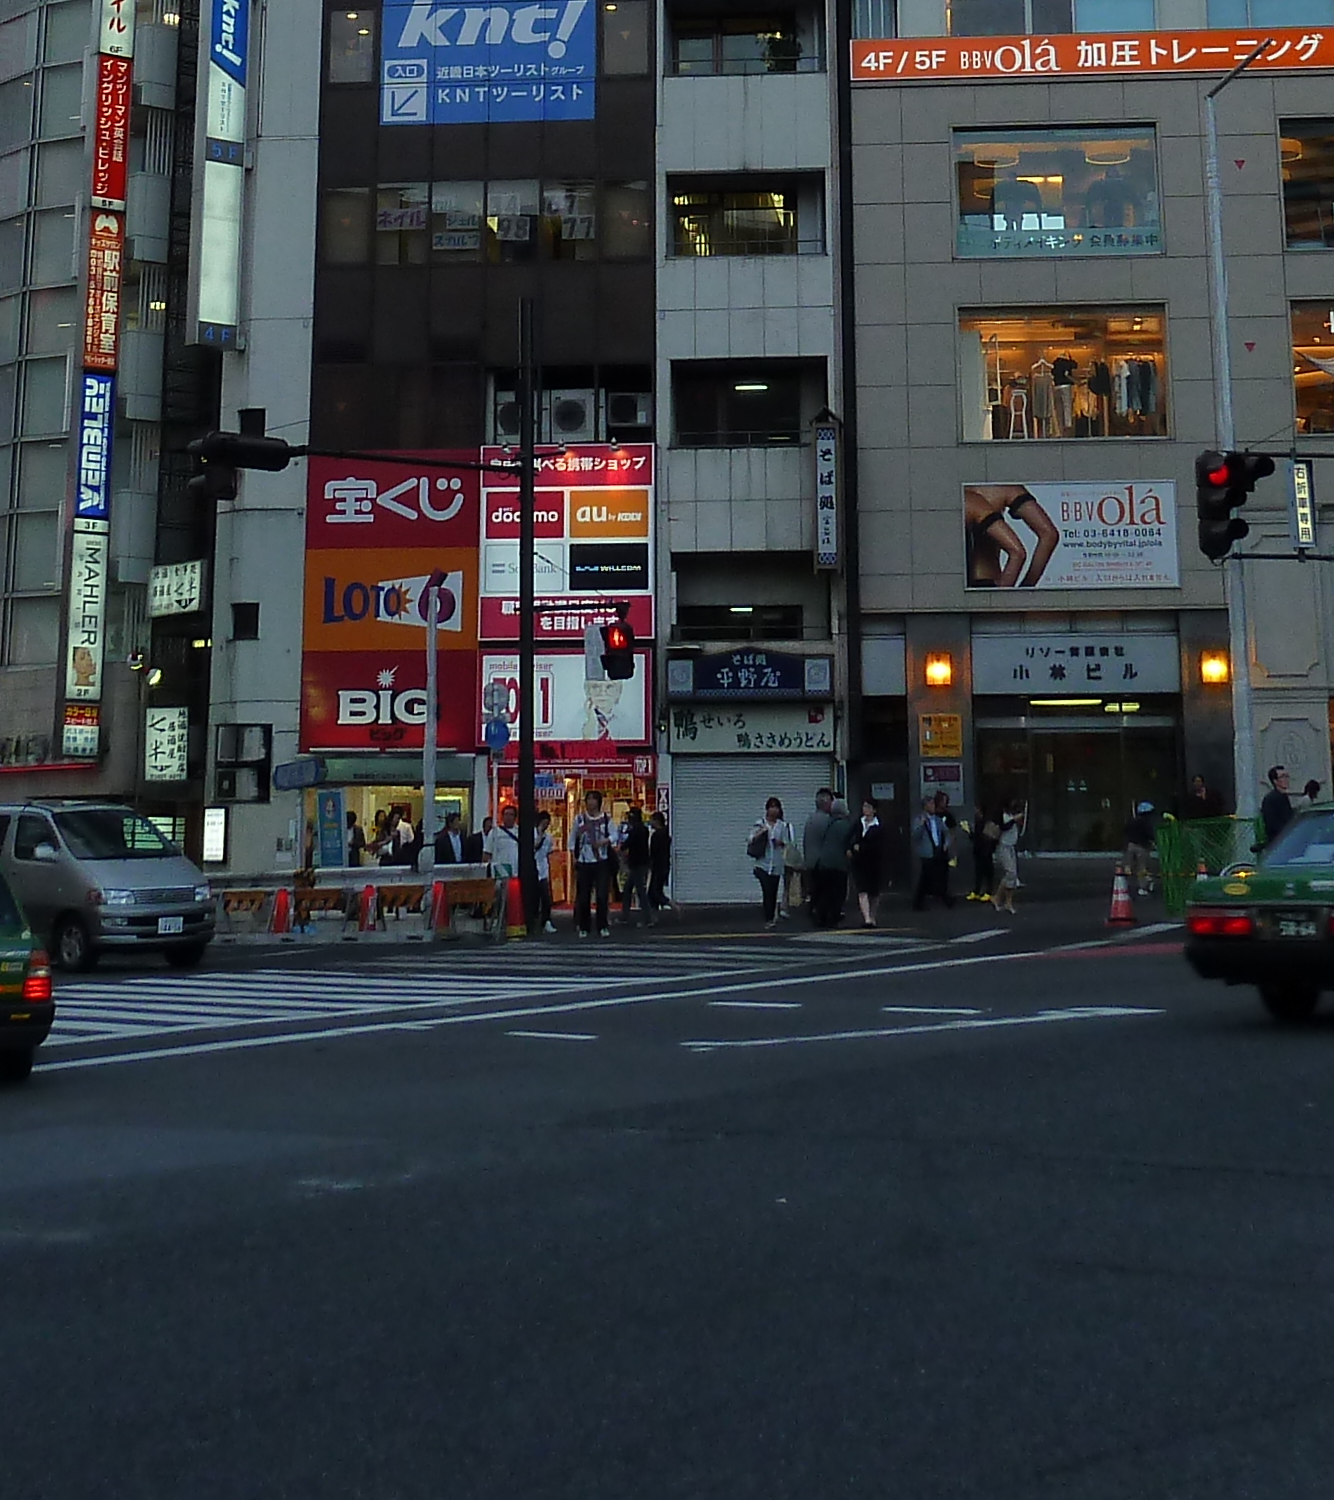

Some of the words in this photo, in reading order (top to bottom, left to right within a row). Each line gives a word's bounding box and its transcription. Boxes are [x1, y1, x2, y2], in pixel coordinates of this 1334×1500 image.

[394, 66, 417, 77] 入口
[100, 250, 120, 354] 駅前保育室
[205, 326, 230, 342] 4F
[79, 377, 105, 512] WEMBLEY
[324, 476, 464, 523] 宝くじ
[492, 508, 559, 523] docmo
[576, 506, 607, 523] au
[84, 521, 98, 530] 3F
[508, 562, 557, 574] SoBank
[81, 546, 102, 646] MAHLER
[323, 577, 401, 624] LOTO
[1012, 663, 1139, 682] 小林ビル
[337, 689, 437, 726] BIG
